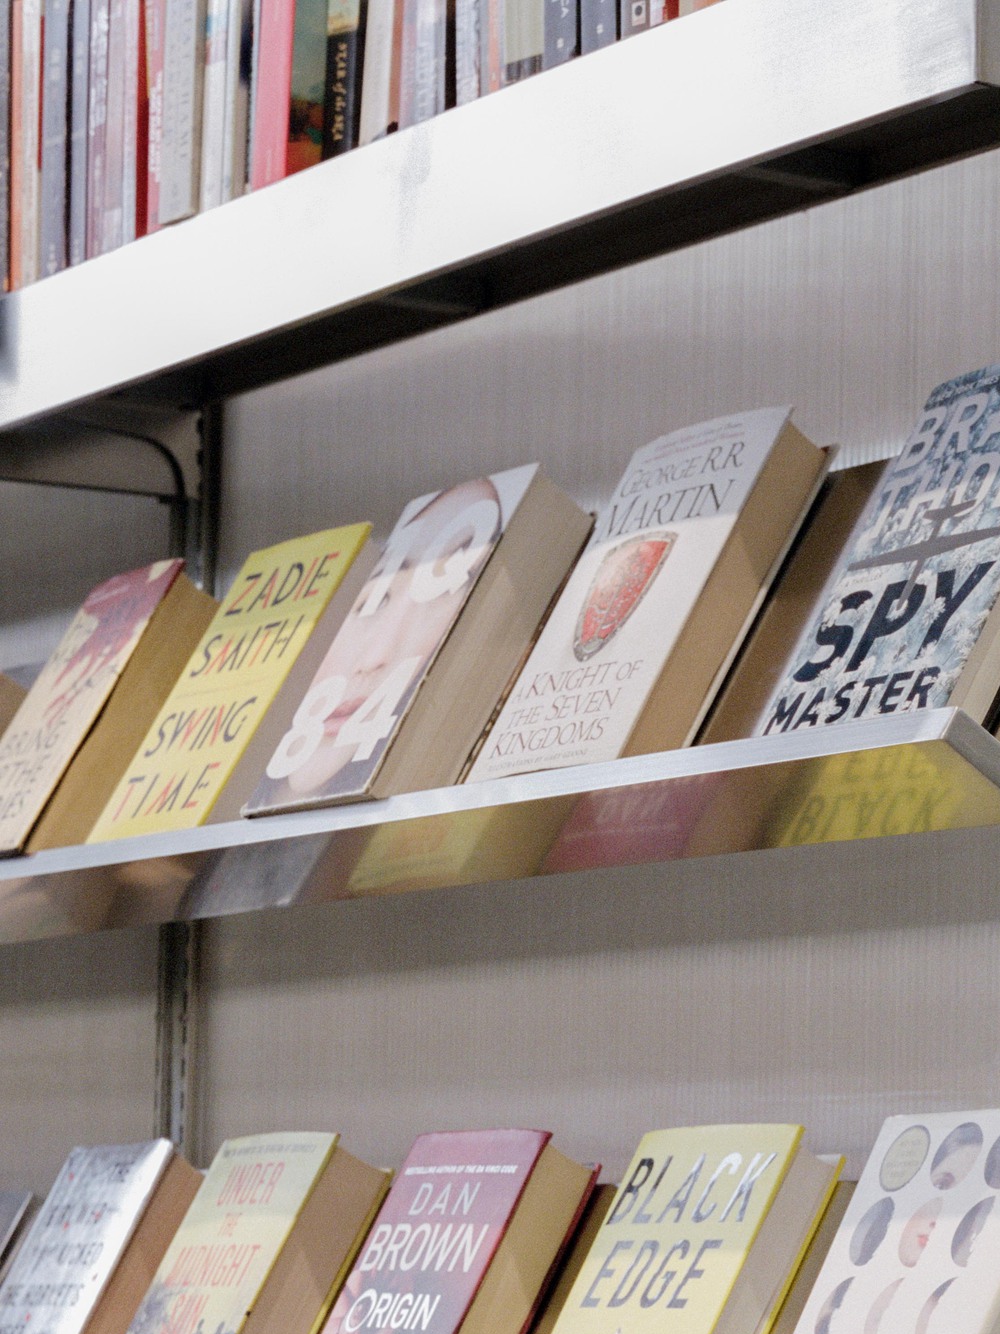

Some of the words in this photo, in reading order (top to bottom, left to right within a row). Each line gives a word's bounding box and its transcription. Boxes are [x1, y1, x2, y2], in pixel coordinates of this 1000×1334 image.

[596, 478, 736, 543] MARTIN
[224, 551, 341, 618] ZADIE
[188, 614, 305, 679] SMITH
[792, 559, 997, 683] SPY
[506, 705, 544, 730] THE
[544, 687, 623, 722] SEVEN
[525, 660, 618, 700] KNIGHT
[615, 659, 644, 681] OF
[763, 666, 941, 737] MASTER
[144, 696, 257, 758] SWING
[265, 654, 423, 780] 84
[487, 716, 610, 760] KINGDOMS
[112, 762, 221, 822] TIME
[216, 1161, 286, 1207] UNDER
[408, 1181, 481, 1216] DAN
[606, 1151, 779, 1226] BLACK
[165, 1243, 262, 1289] MIDNIGHT
[359, 1222, 490, 1273] BROWN
[579, 1238, 725, 1310] EDGE
[344, 1288, 441, 1333] ORIGIN
